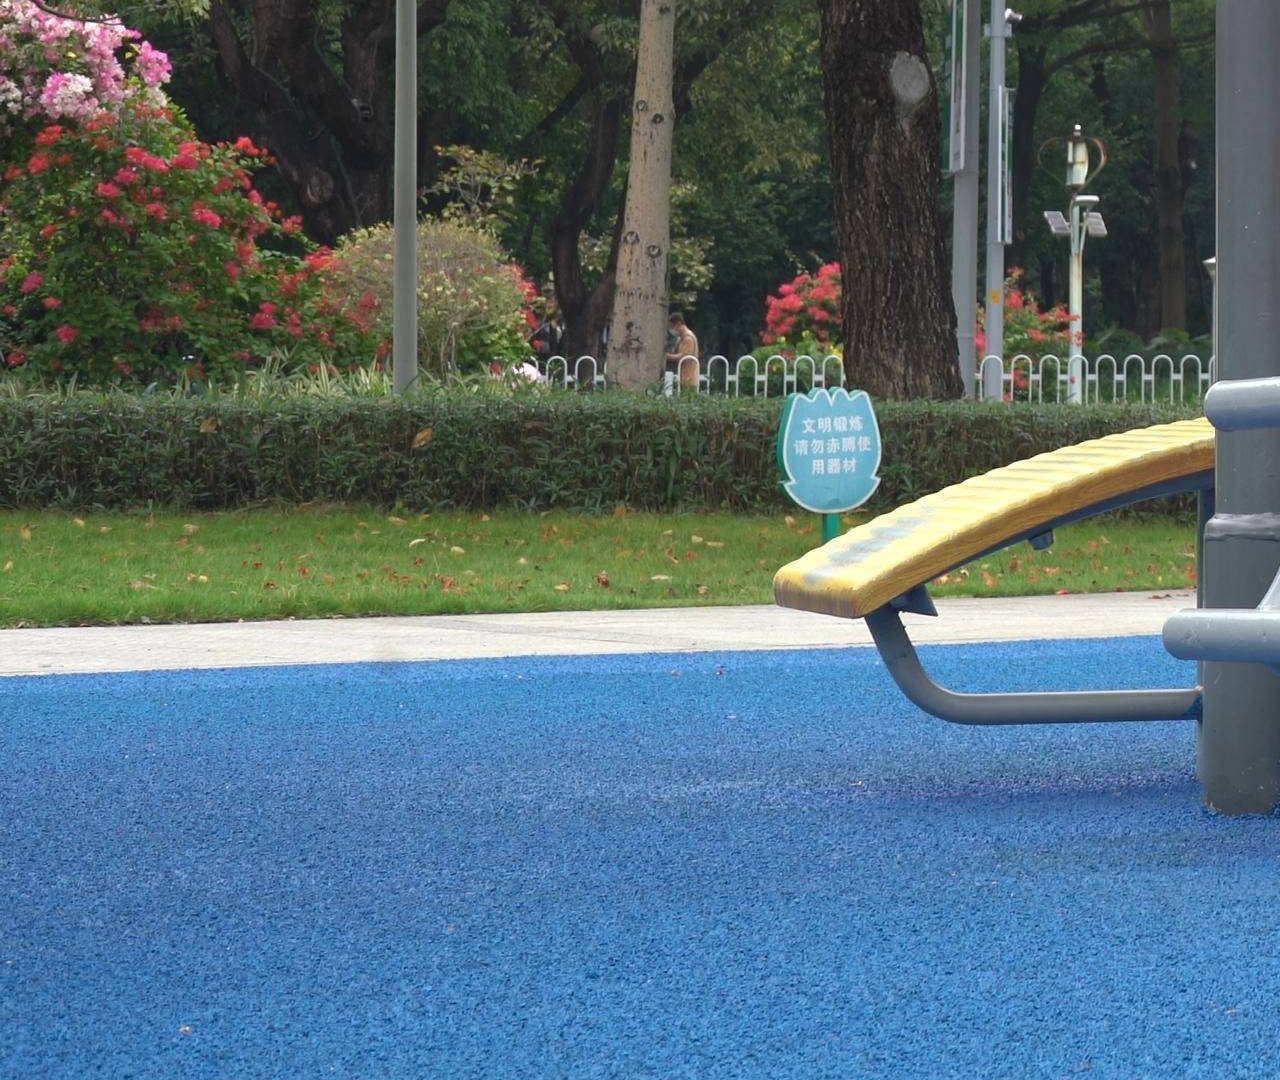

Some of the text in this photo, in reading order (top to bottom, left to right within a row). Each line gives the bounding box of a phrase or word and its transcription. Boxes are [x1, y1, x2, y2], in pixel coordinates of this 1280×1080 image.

[802, 415, 863, 434] 文明锻炼
[793, 436, 872, 456] 请勿赤膊使
[811, 457, 857, 474] 用器材
